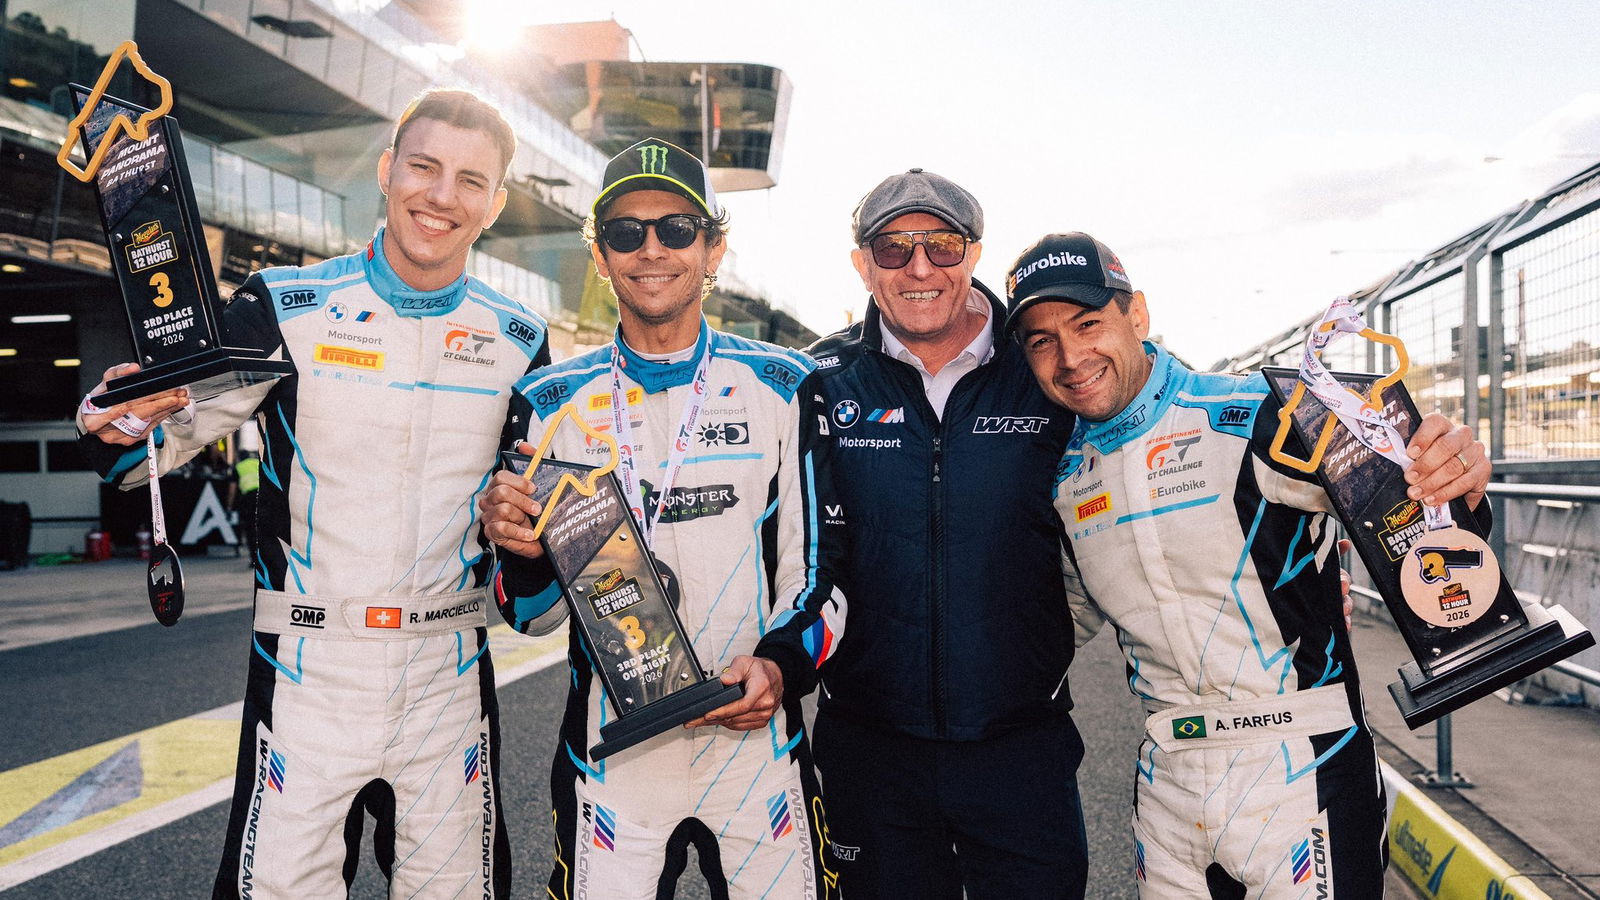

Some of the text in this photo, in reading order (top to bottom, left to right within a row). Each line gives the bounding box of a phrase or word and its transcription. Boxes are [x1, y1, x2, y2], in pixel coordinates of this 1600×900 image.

[118, 133, 160, 159] MOUNT
[101, 144, 165, 180] PANORAMA
[106, 160, 156, 188] BATHURST
[131, 240, 171, 260] BATHURST
[134, 249, 174, 268] 12 HOUR
[1016, 251, 1088, 285] Eurobike
[149, 272, 174, 308] 3
[281, 292, 317, 306] OMP
[402, 291, 458, 309] WRT
[143, 306, 194, 329] 3RD PLACE
[147, 318, 194, 339] OUTRIGHT
[162, 332, 184, 346] 2026
[328, 330, 382, 345] Motorsport
[508, 320, 537, 343] OMP
[320, 347, 378, 367] PIRELLI
[454, 353, 496, 366] CHALLENGE
[763, 363, 799, 386] OMP
[536, 384, 569, 406] OMP
[972, 416, 1049, 434] WRT
[1098, 404, 1147, 446] WRT
[1219, 409, 1250, 422] OMP
[839, 436, 902, 450] Motorsport
[1146, 428, 1202, 446] INTERCONTINENTAL
[1148, 461, 1203, 480] GT CHALLENGE
[649, 489, 732, 510] MONSTER
[1073, 480, 1103, 498] Motorsport
[1157, 480, 1206, 498] Eurobike
[566, 486, 608, 517] MOUNT
[661, 506, 718, 518] ENERGY
[1078, 496, 1108, 520] PIRELLI
[550, 496, 616, 539] PANORAMA
[557, 512, 608, 546] BATHURST
[1387, 520, 1426, 546] BATHUR
[1392, 542, 1409, 556] 12
[594, 584, 636, 608] BATHURST
[598, 592, 640, 616] 12 HOUR
[1442, 598, 1469, 610] 12 HOUR
[291, 608, 325, 625] OMP
[410, 602, 480, 624] R. MARCIELLO
[1446, 610, 1470, 622] 2026
[620, 615, 646, 650] 3
[616, 644, 670, 672] 3RD PLACE
[622, 654, 672, 681] OUTRIGHT
[640, 670, 663, 686] 2026
[1216, 712, 1293, 731] A. FARFUS
[242, 738, 268, 900] W-RACINGTEAM
[578, 802, 592, 900] W-RACING
